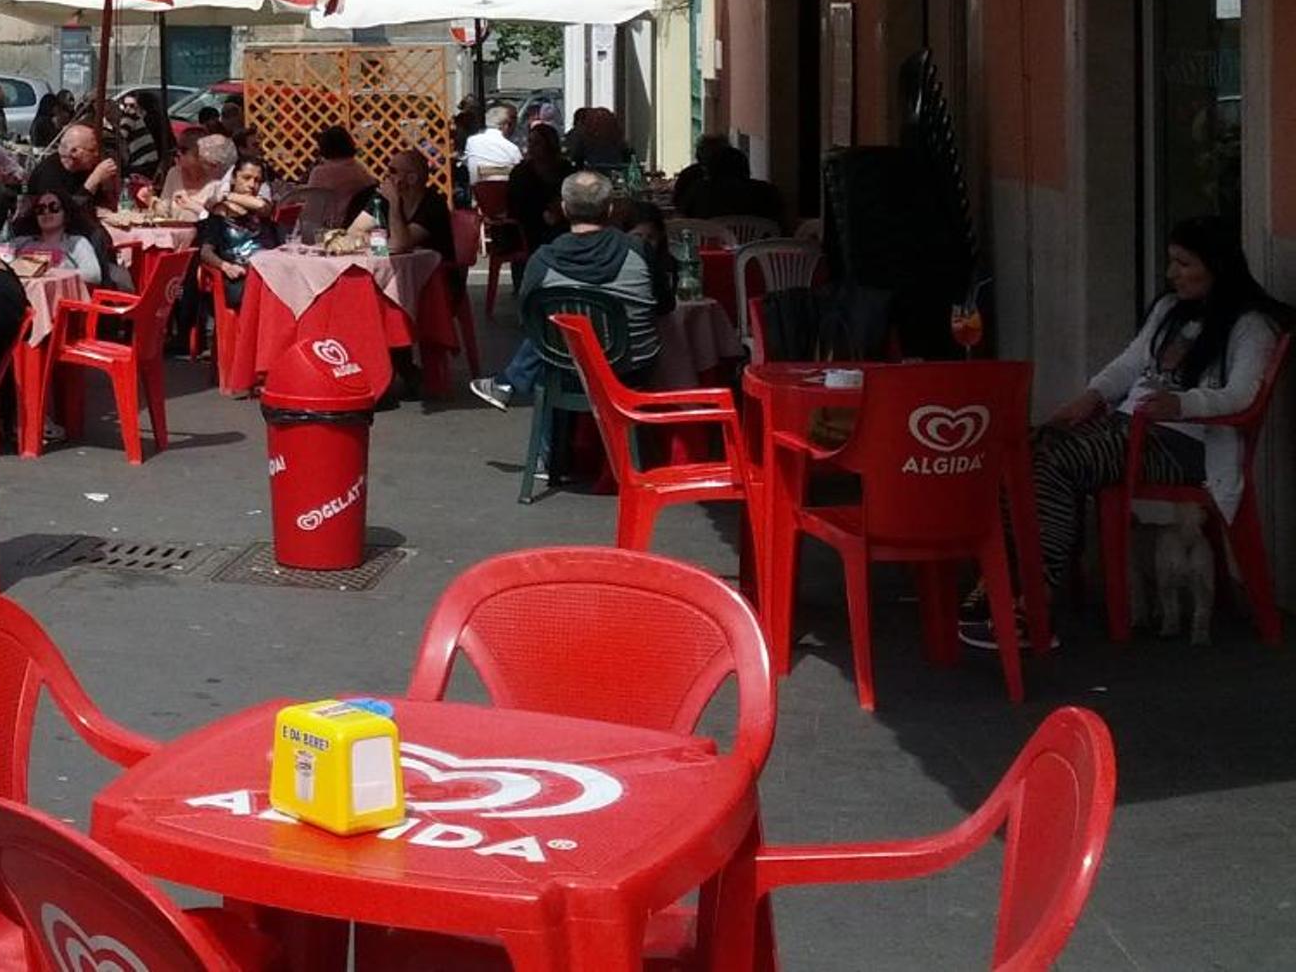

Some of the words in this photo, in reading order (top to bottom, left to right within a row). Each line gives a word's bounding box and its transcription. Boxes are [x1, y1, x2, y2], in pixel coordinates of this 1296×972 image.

[901, 454, 984, 475] ALGIDA
[322, 476, 364, 519] GELAT
[183, 789, 547, 863] AIDA
